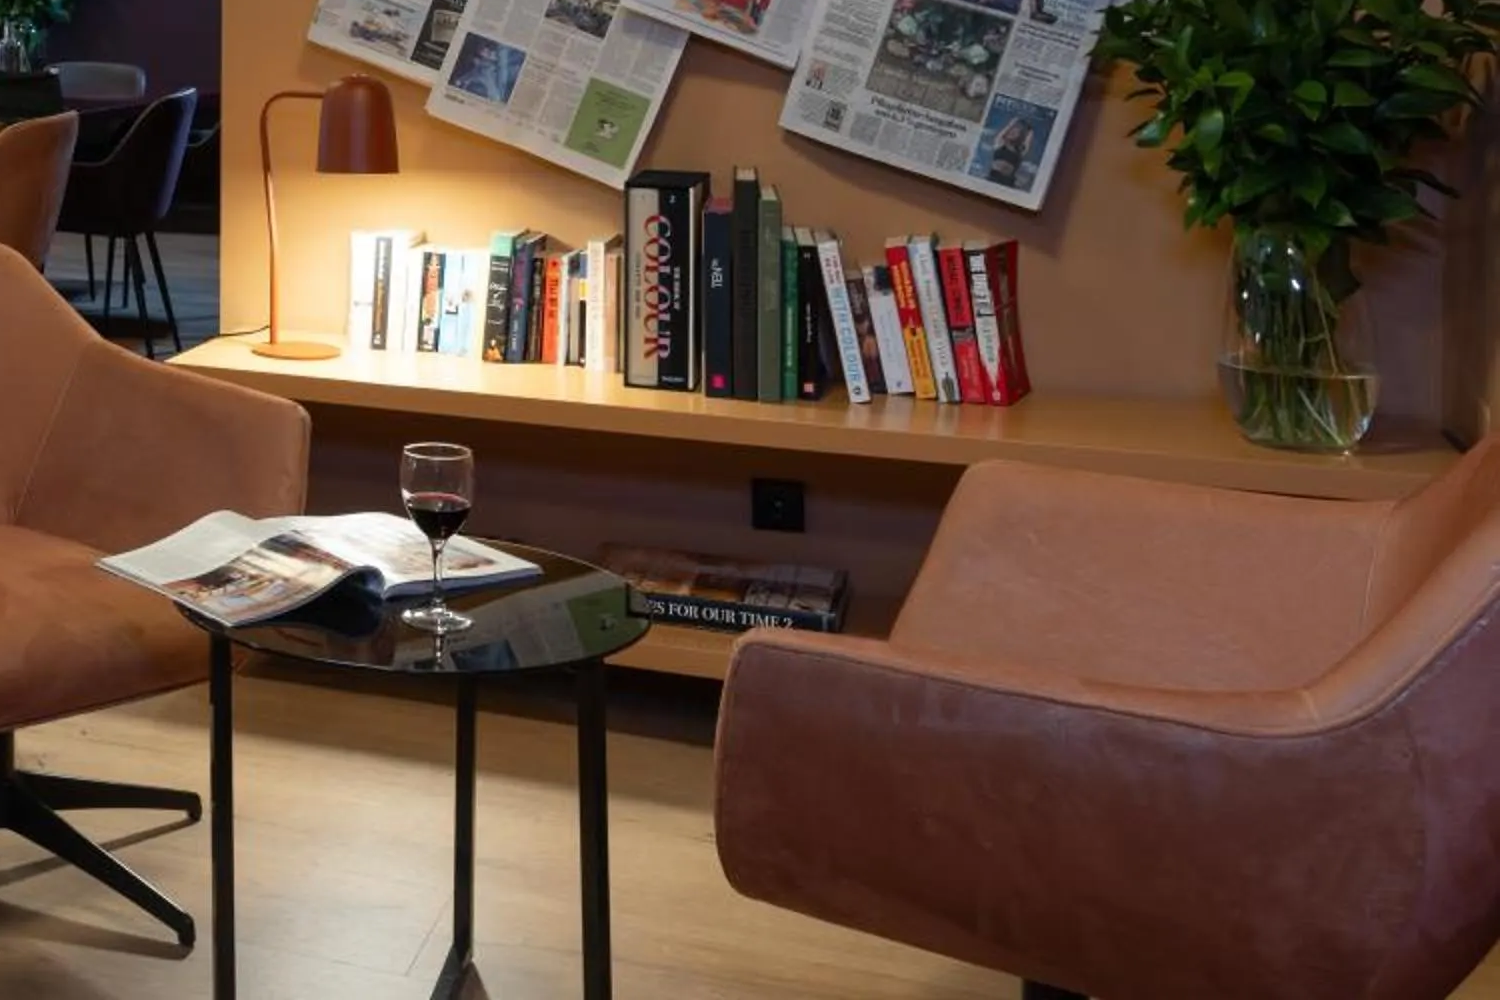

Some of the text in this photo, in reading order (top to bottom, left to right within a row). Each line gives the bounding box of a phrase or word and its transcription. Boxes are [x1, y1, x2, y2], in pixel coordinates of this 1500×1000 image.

[643, 214, 672, 360] COLOUR
[839, 327, 861, 381] COLOUR
[668, 603, 700, 619] FOR
[702, 606, 736, 623] OUR
[739, 611, 781, 628] TIME
